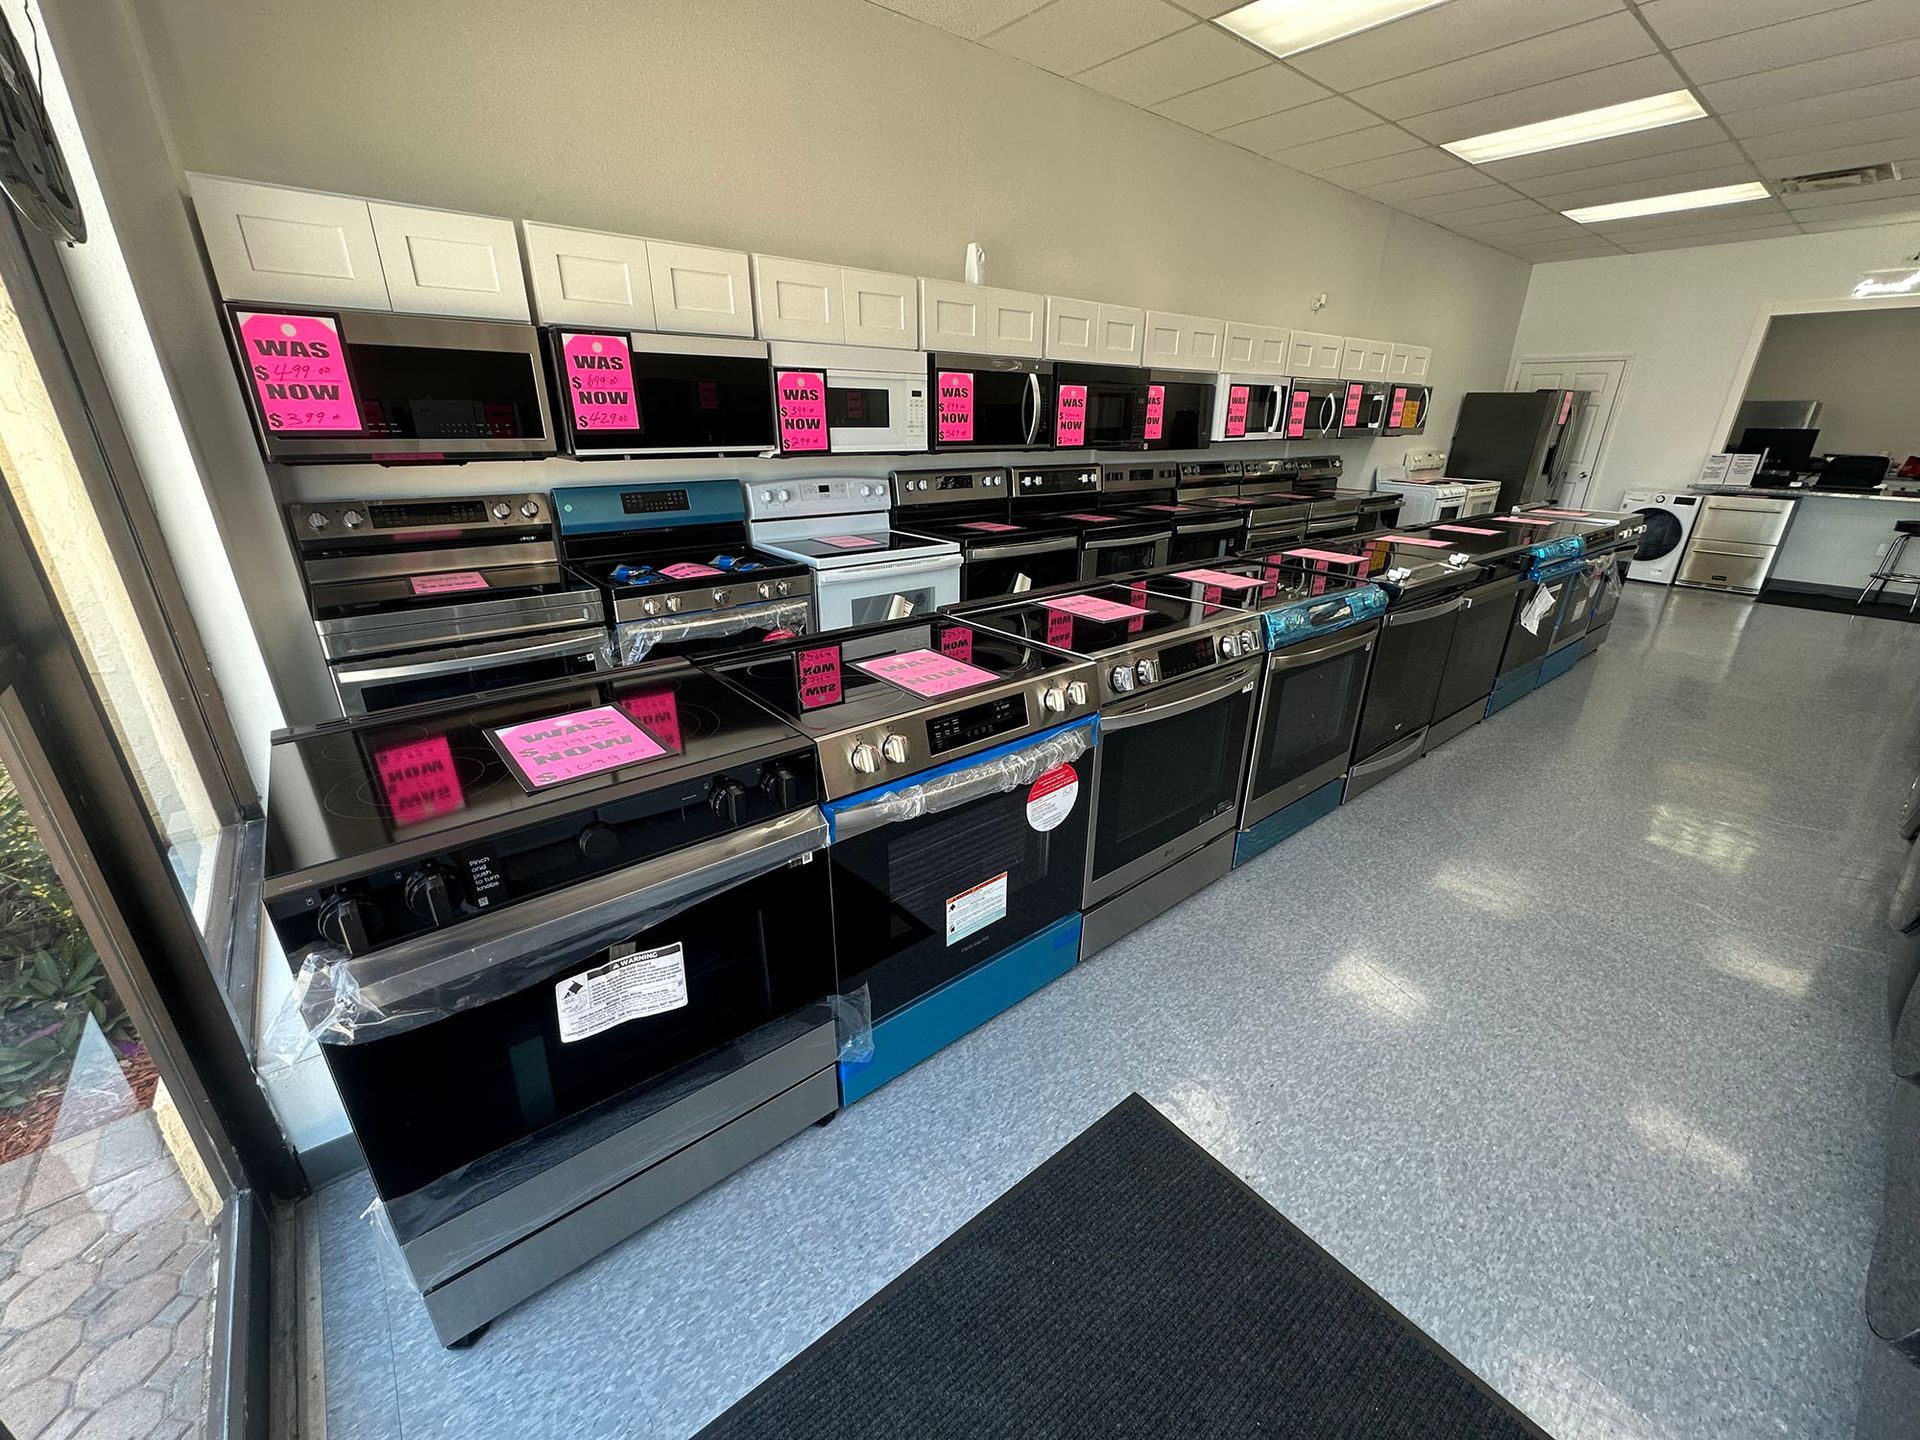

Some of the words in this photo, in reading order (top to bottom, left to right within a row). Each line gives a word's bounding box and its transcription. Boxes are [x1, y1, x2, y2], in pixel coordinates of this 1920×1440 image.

[253, 339, 330, 358] WAS
[573, 355, 624, 370] WAS
[265, 384, 340, 400] NOW
[578, 391, 628, 404] NOW
[783, 389, 819, 401] WAS
[941, 387, 969, 398] WAS
[1062, 398, 1084, 408] WAS
[785, 418, 821, 430] NOW
[941, 413, 969, 423] NOW
[1146, 417, 1160, 425] OW
[1060, 421, 1082, 430] NOW
[904, 666, 967, 686] NOW
[519, 717, 616, 743] WAS
[532, 734, 633, 766] NOW
[471, 864, 487, 872] and
[476, 881, 499, 891] knobs
[620, 951, 658, 966] WARNING
